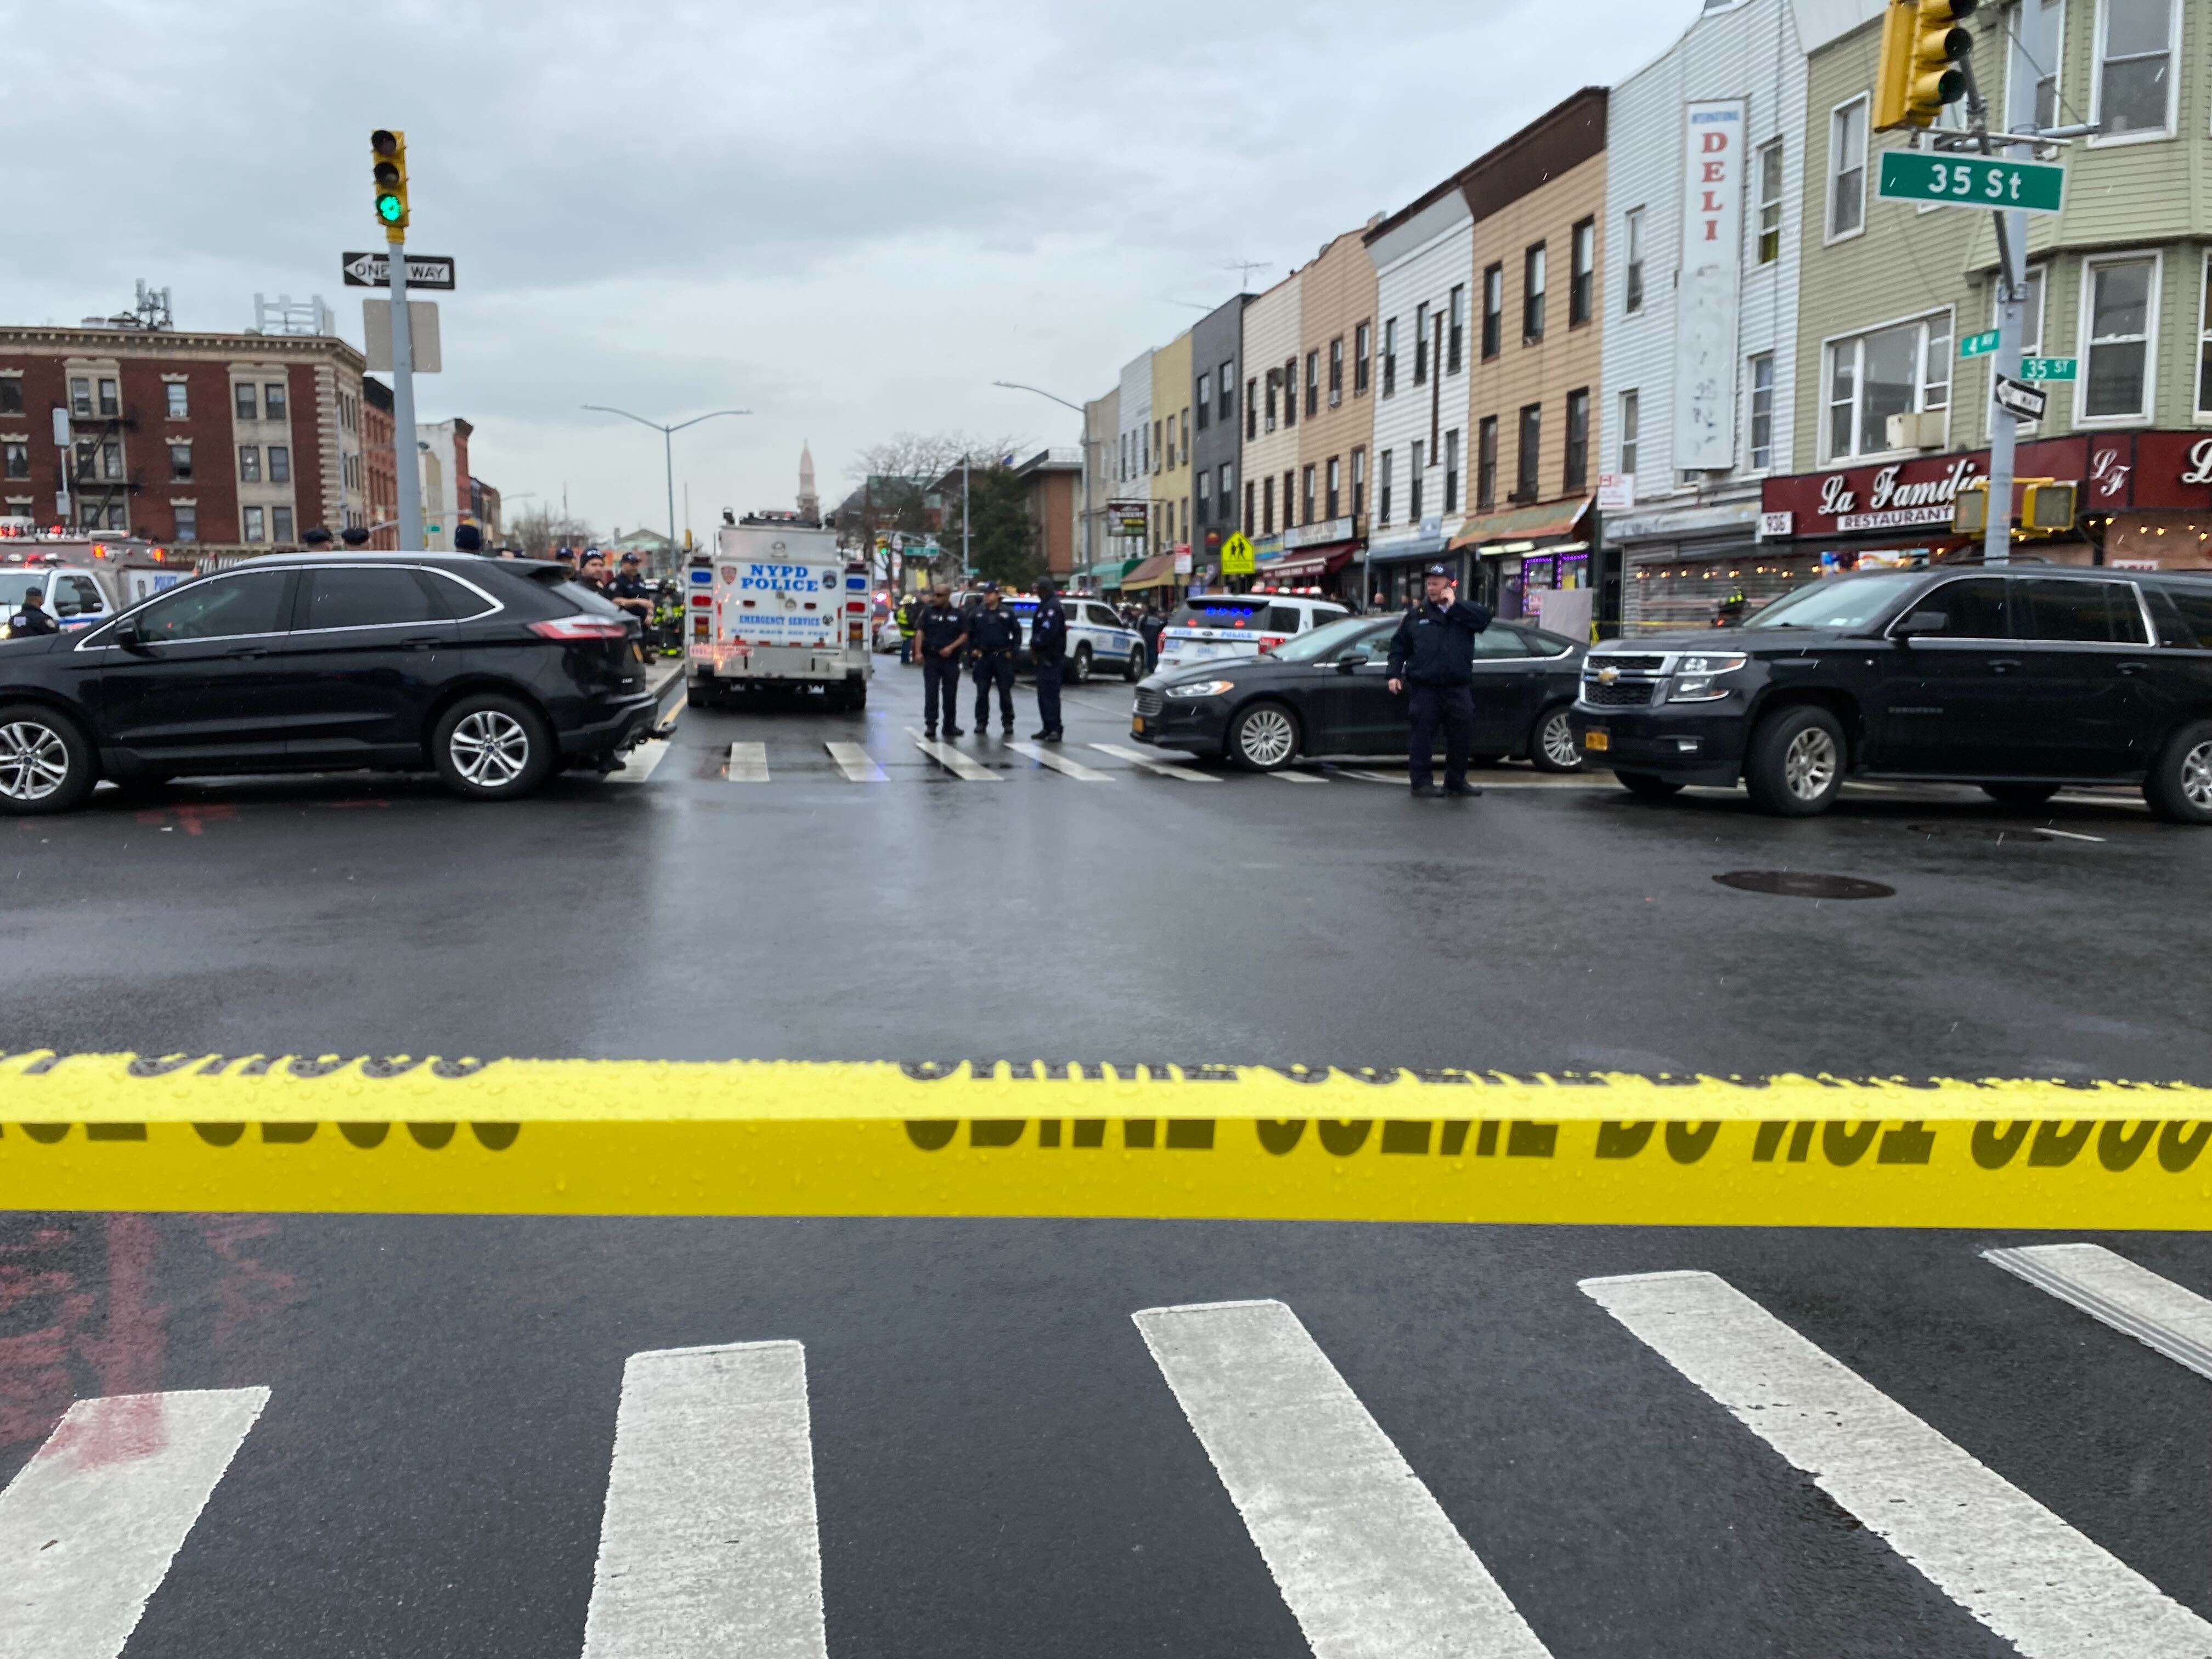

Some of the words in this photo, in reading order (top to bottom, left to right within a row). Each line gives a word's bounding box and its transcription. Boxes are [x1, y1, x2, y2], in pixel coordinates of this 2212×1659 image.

[1701, 132, 1728, 240] DELI
[1928, 163, 1972, 195] 35
[1984, 168, 2022, 200] St
[355, 262, 390, 278] ONE
[411, 266, 444, 278] WAY
[1968, 337, 1978, 352] 4
[2027, 359, 2047, 378] 35
[2054, 360, 2070, 373] ST
[1818, 475, 1855, 515] La
[1844, 505, 1951, 528] RESTAURANT
[751, 565, 808, 578] NYPD
[741, 578, 818, 592] POLICE
[740, 615, 785, 624] EMERGENCY
[788, 617, 820, 626] SERVICE
